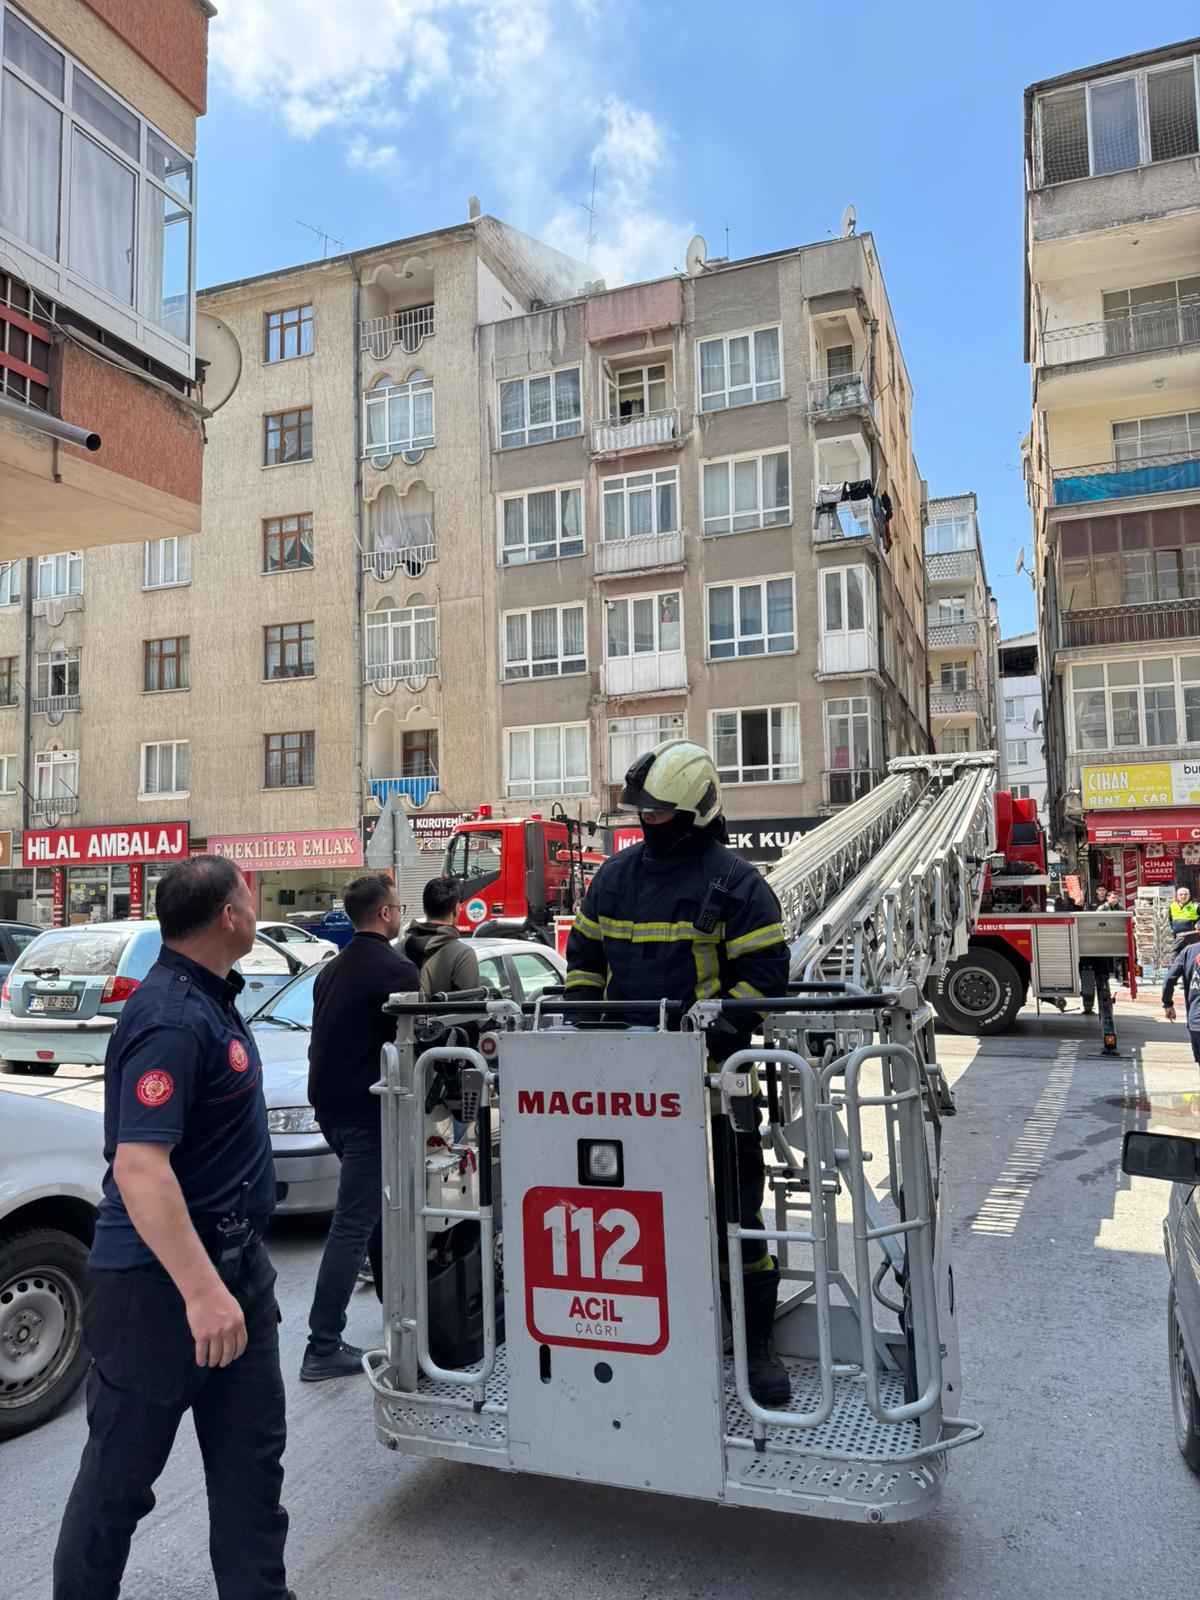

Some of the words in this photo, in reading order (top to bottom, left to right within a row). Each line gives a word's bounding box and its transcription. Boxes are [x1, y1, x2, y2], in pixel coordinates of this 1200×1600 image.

[1184, 764, 1200, 775] bu
[1127, 794, 1136, 803] A
[1143, 792, 1168, 803] CAR
[416, 814, 465, 829] KURUYEMİ
[87, 829, 183, 858] AMBALAJ
[215, 837, 296, 859] EMEKLİLER
[303, 838, 354, 856] EMLAK
[760, 831, 804, 848] KUA
[518, 1090, 681, 1118] MAGIRUS
[543, 1206, 643, 1282] 112
[575, 1322, 618, 1337] ÇAĞRI
